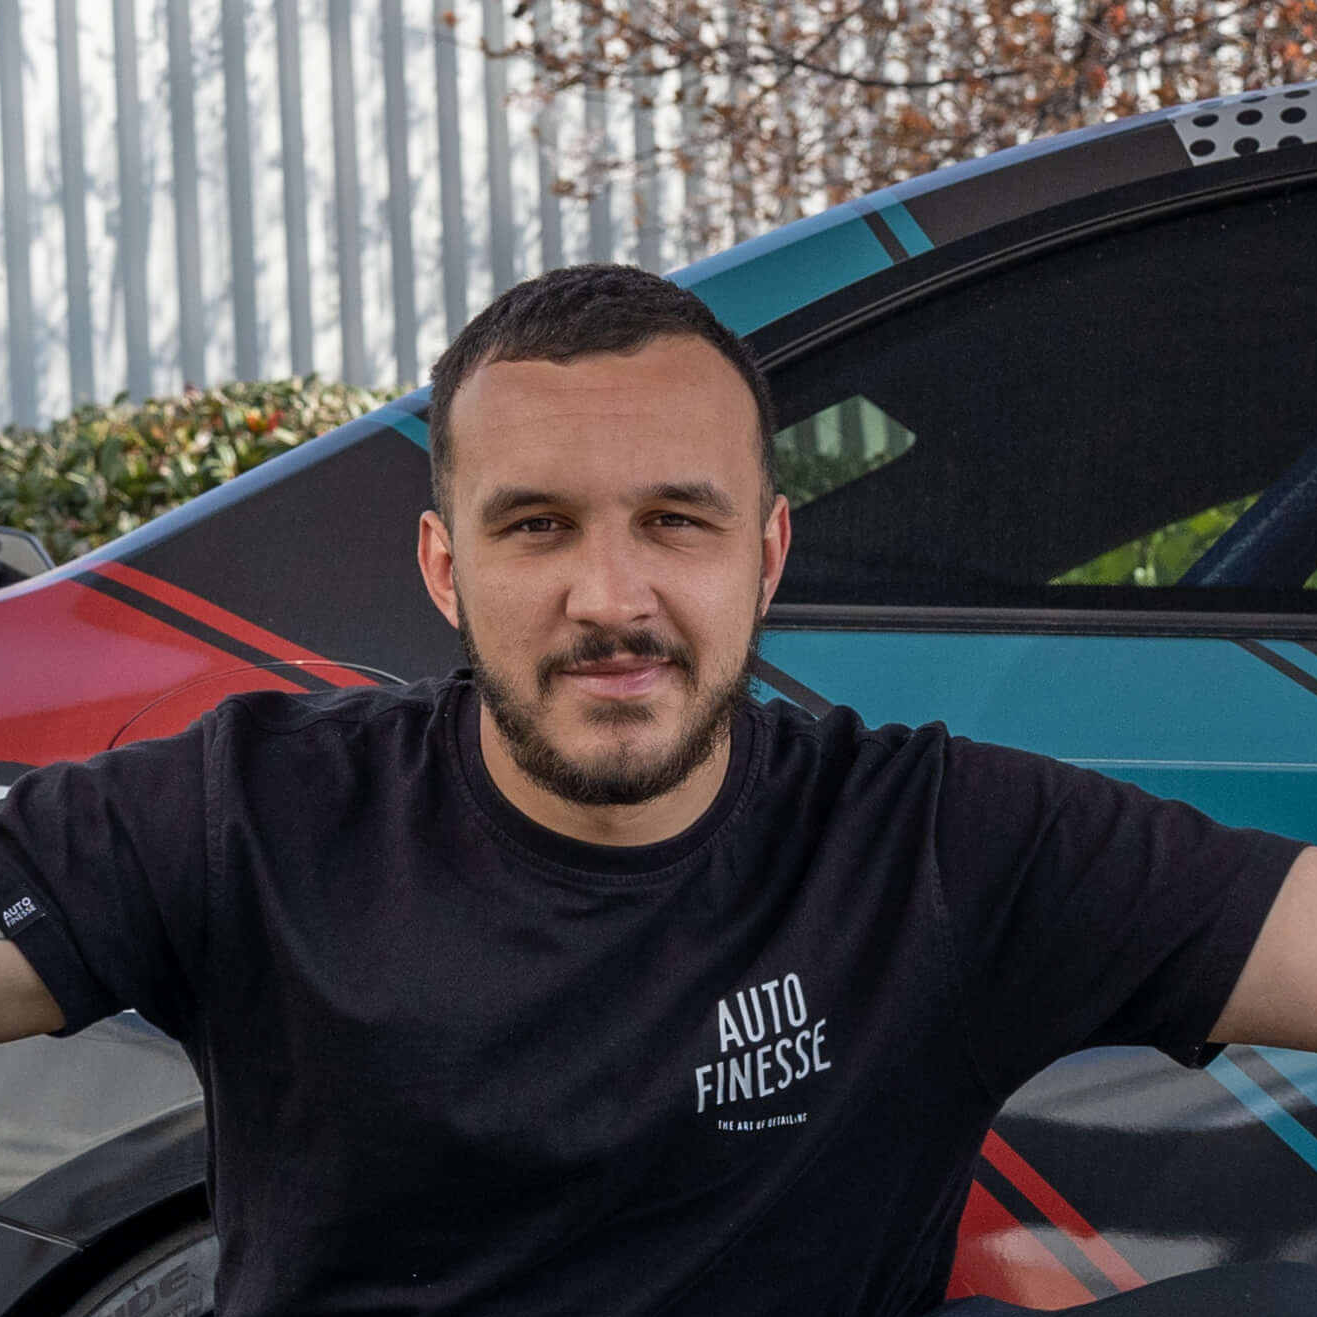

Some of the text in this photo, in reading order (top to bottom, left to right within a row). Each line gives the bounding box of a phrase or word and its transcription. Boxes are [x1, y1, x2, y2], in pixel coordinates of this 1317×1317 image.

[3, 897, 31, 921] AUTO
[718, 973, 808, 1053] AUTO
[695, 1018, 832, 1113] FINESSE
[718, 1112, 808, 1131] THE ART OF DETAILING
